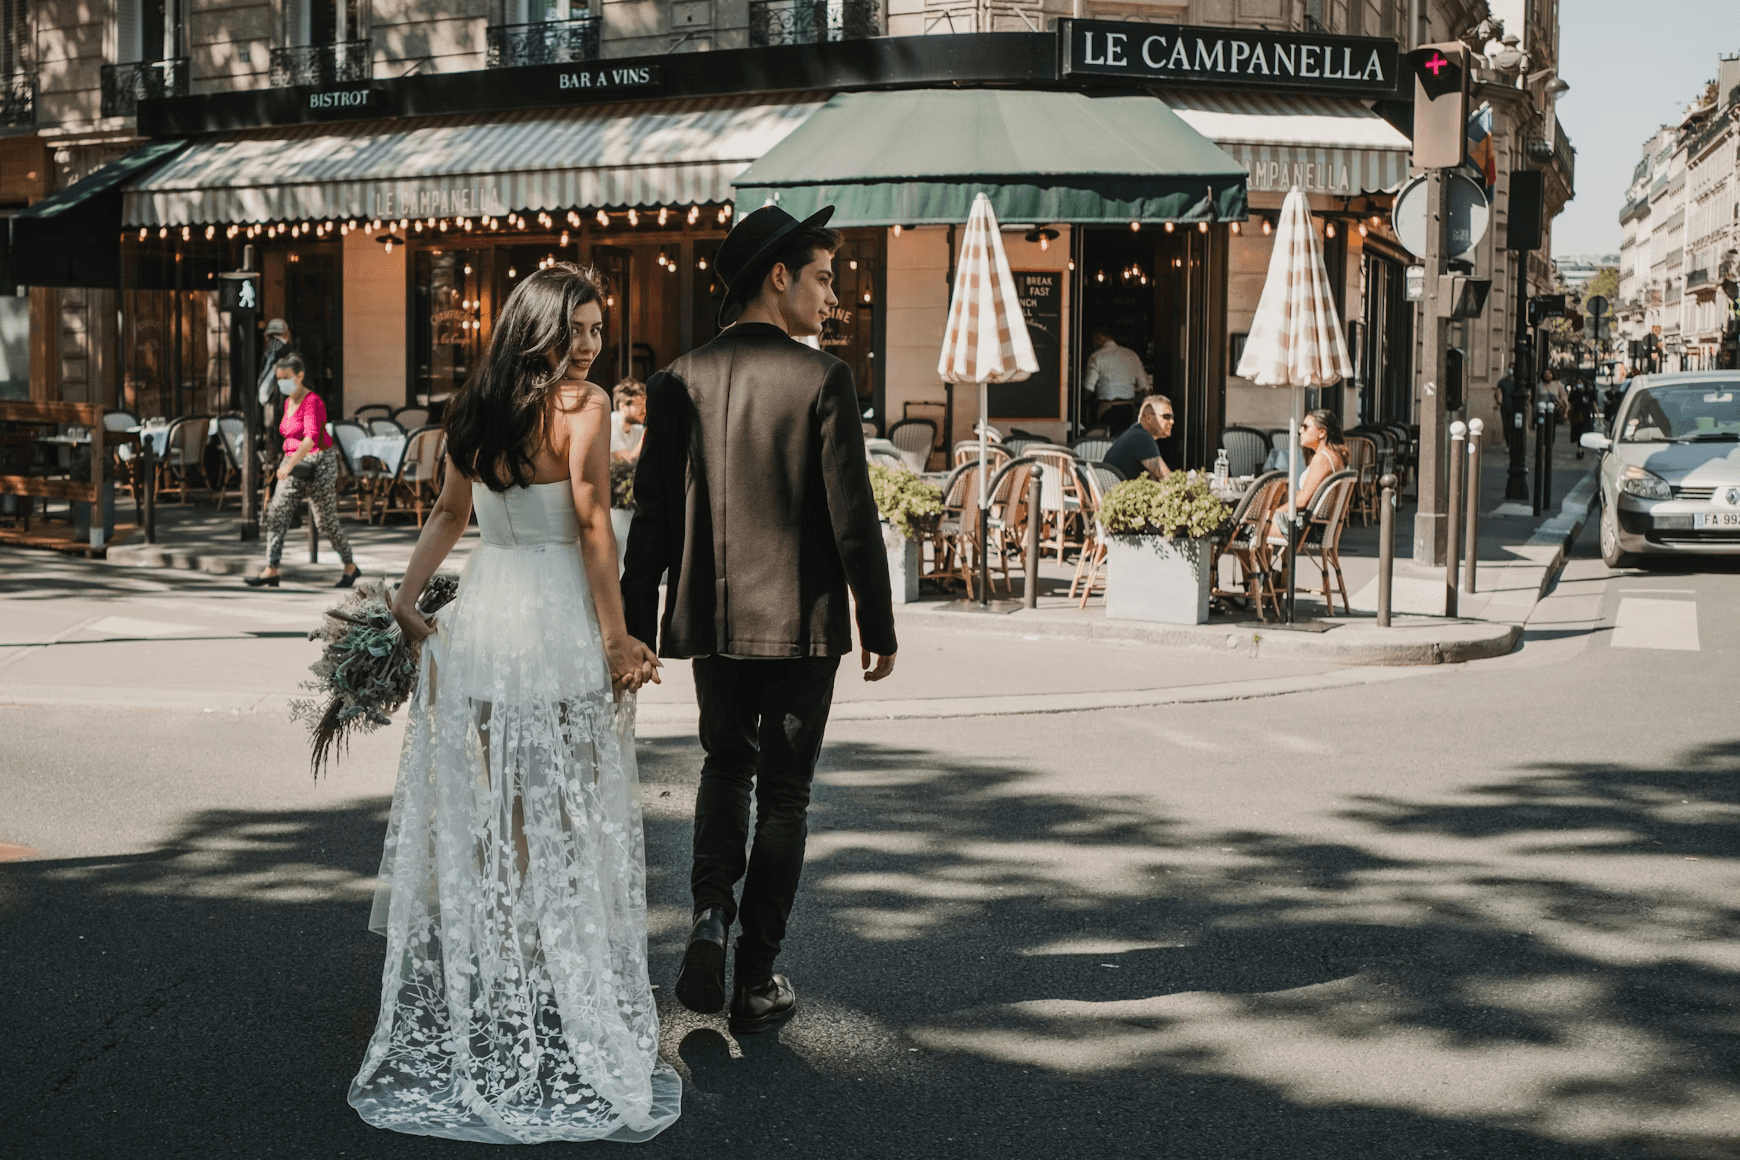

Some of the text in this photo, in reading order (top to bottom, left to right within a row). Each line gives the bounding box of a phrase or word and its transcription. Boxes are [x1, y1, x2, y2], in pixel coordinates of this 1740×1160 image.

[1083, 31, 1386, 82] LE CAMPANELLA
[559, 67, 650, 89] BAR A VINS
[310, 90, 370, 108] BISTROT
[1244, 160, 1349, 191] AMPANELLA
[376, 187, 500, 217] LE CAMPANELLA
[1026, 276, 1053, 286] BREAK
[1029, 287, 1050, 297] FAST
[1704, 514, 1740, 525] FA-99
